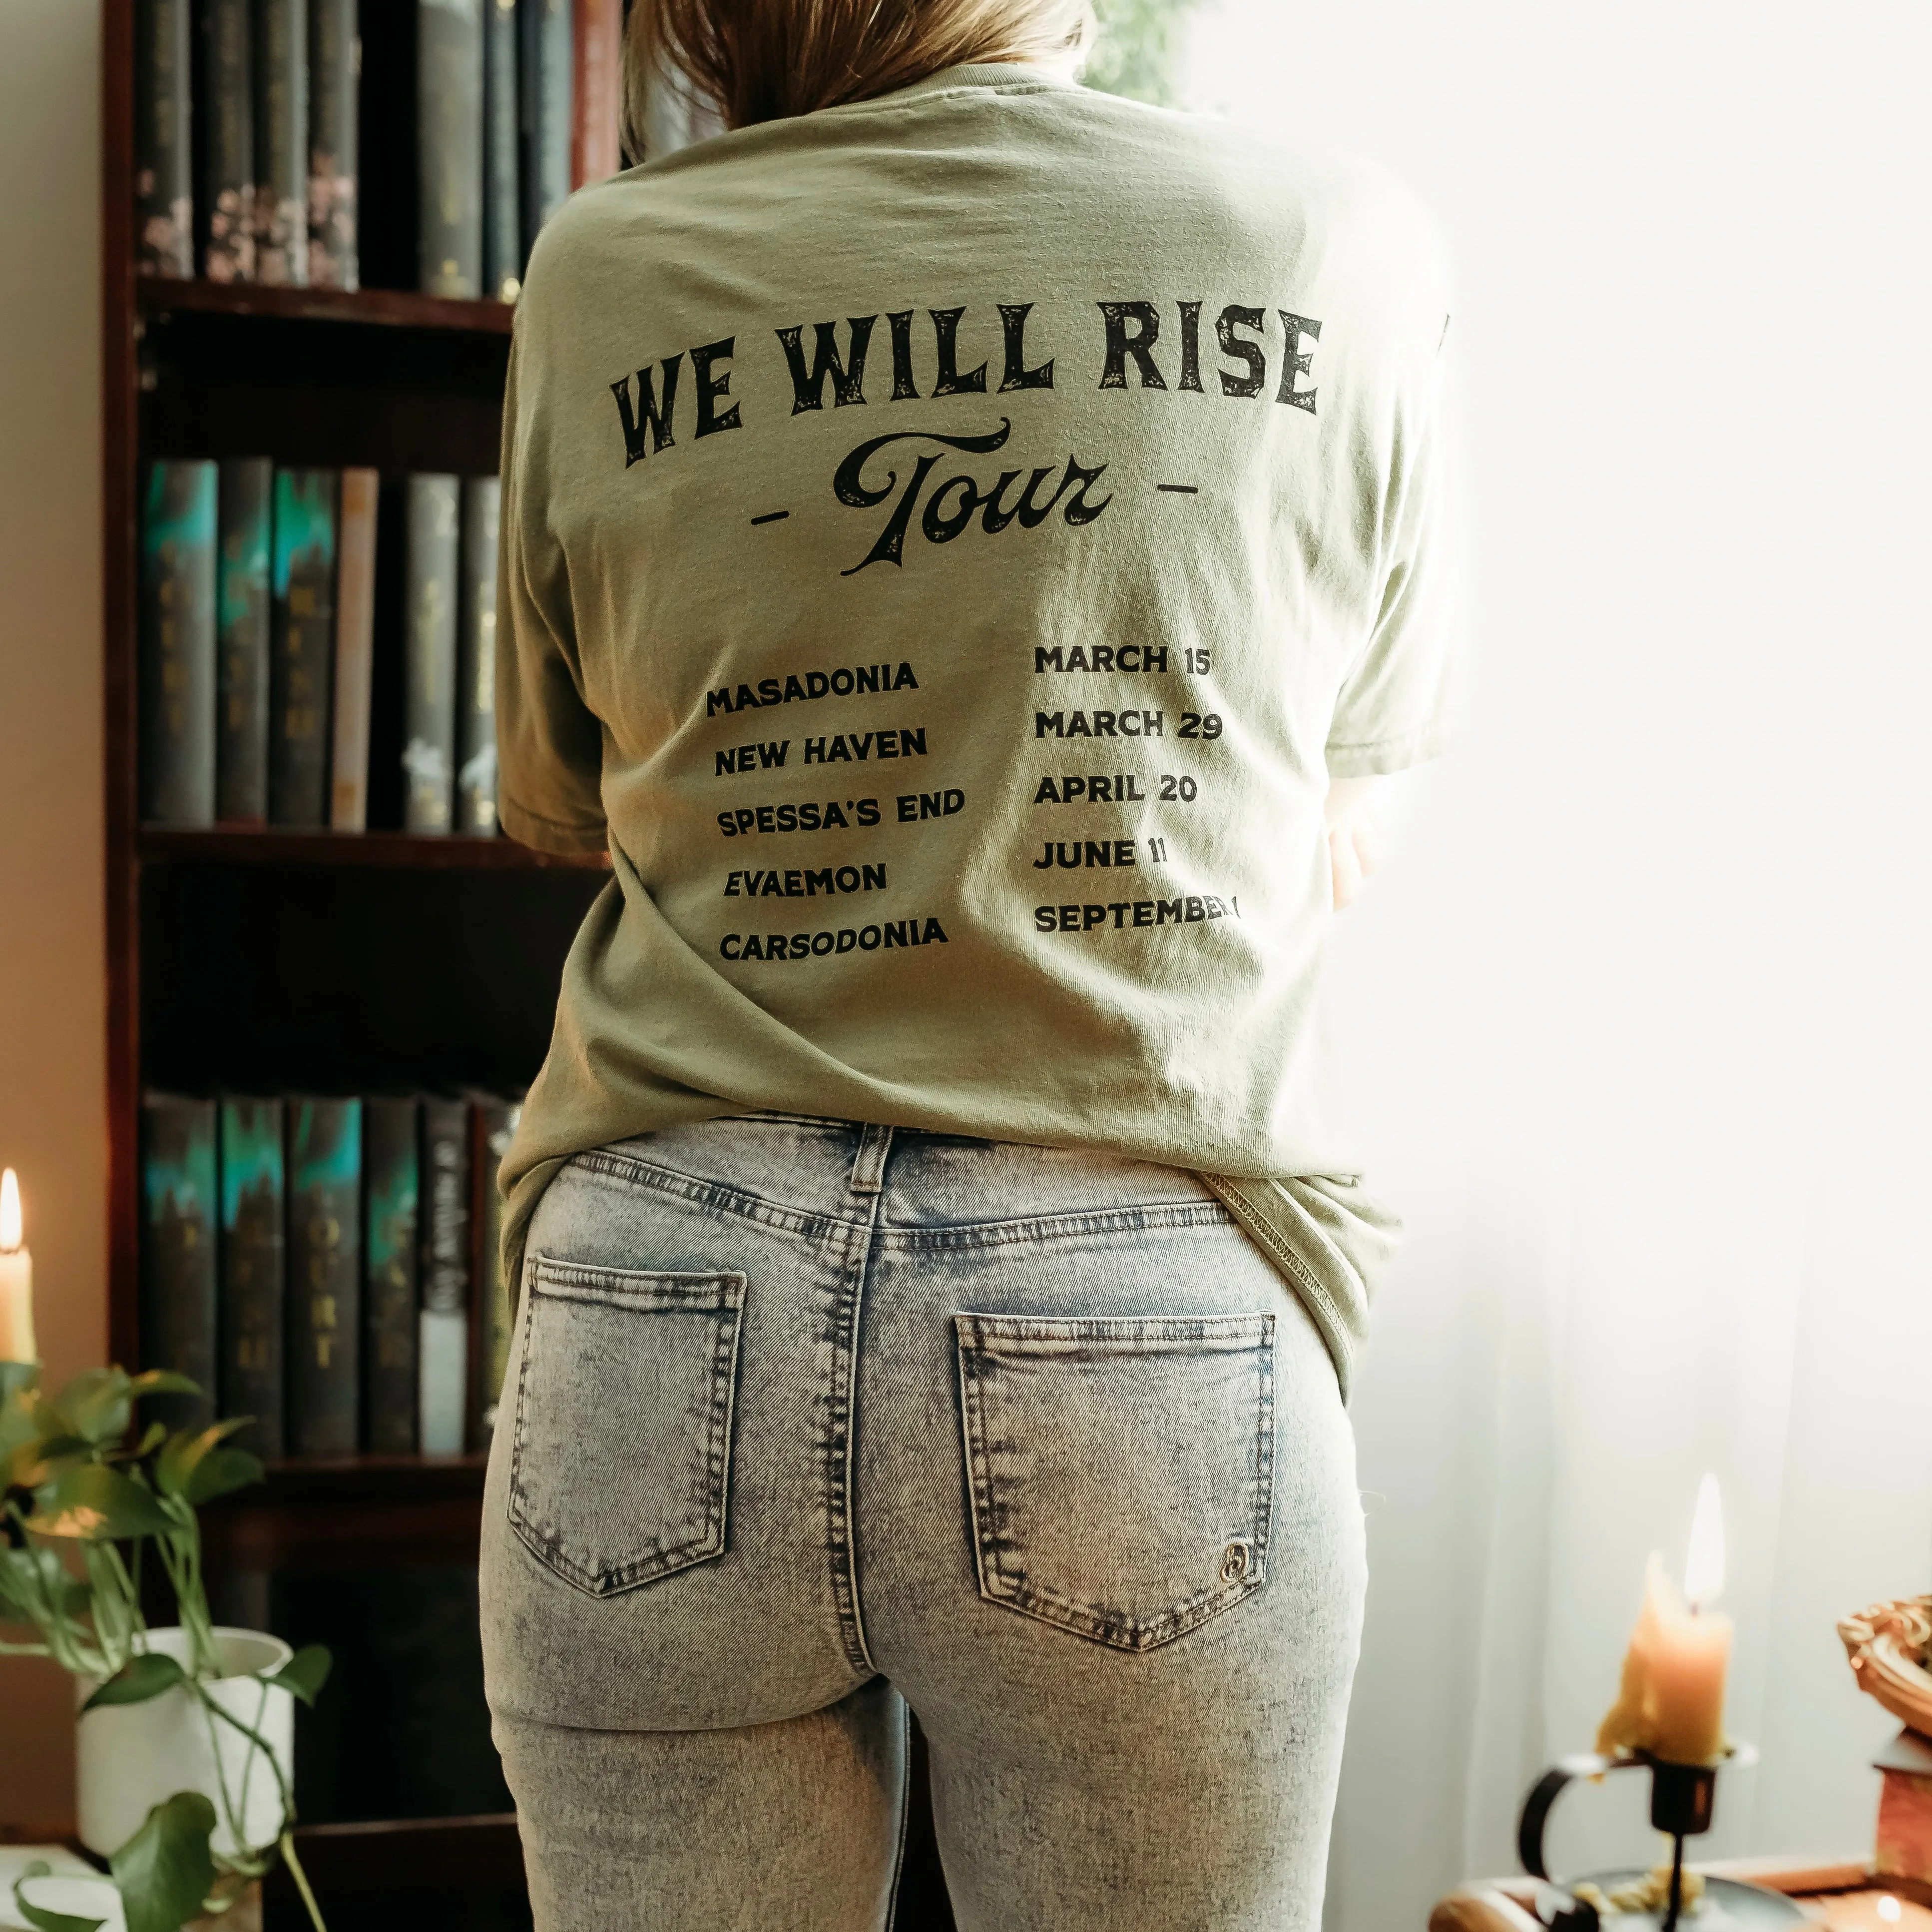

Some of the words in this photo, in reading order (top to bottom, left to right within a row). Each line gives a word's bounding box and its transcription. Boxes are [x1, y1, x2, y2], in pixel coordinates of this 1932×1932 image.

[609, 336, 743, 470] WE
[774, 301, 1055, 417] WILL
[1095, 300, 1323, 416] RISE
[833, 417, 1112, 576] Tour
[1034, 644, 1168, 673] MARCH
[1185, 647, 1210, 675] 15
[707, 662, 919, 718] MASADONIA
[1035, 710, 1164, 739] MARCH
[1178, 712, 1223, 740] 29
[715, 740, 791, 777] NEW
[804, 727, 928, 764] HAVEN
[1032, 774, 1145, 804] APRIL
[1159, 774, 1197, 802] 20
[717, 798, 881, 837] SPESSA'S
[896, 788, 965, 823] END
[1032, 840, 1136, 870] JUNE
[1147, 837, 1167, 863] 11
[723, 863, 887, 898] EVAEMON
[720, 917, 949, 961] CARSODONIA
